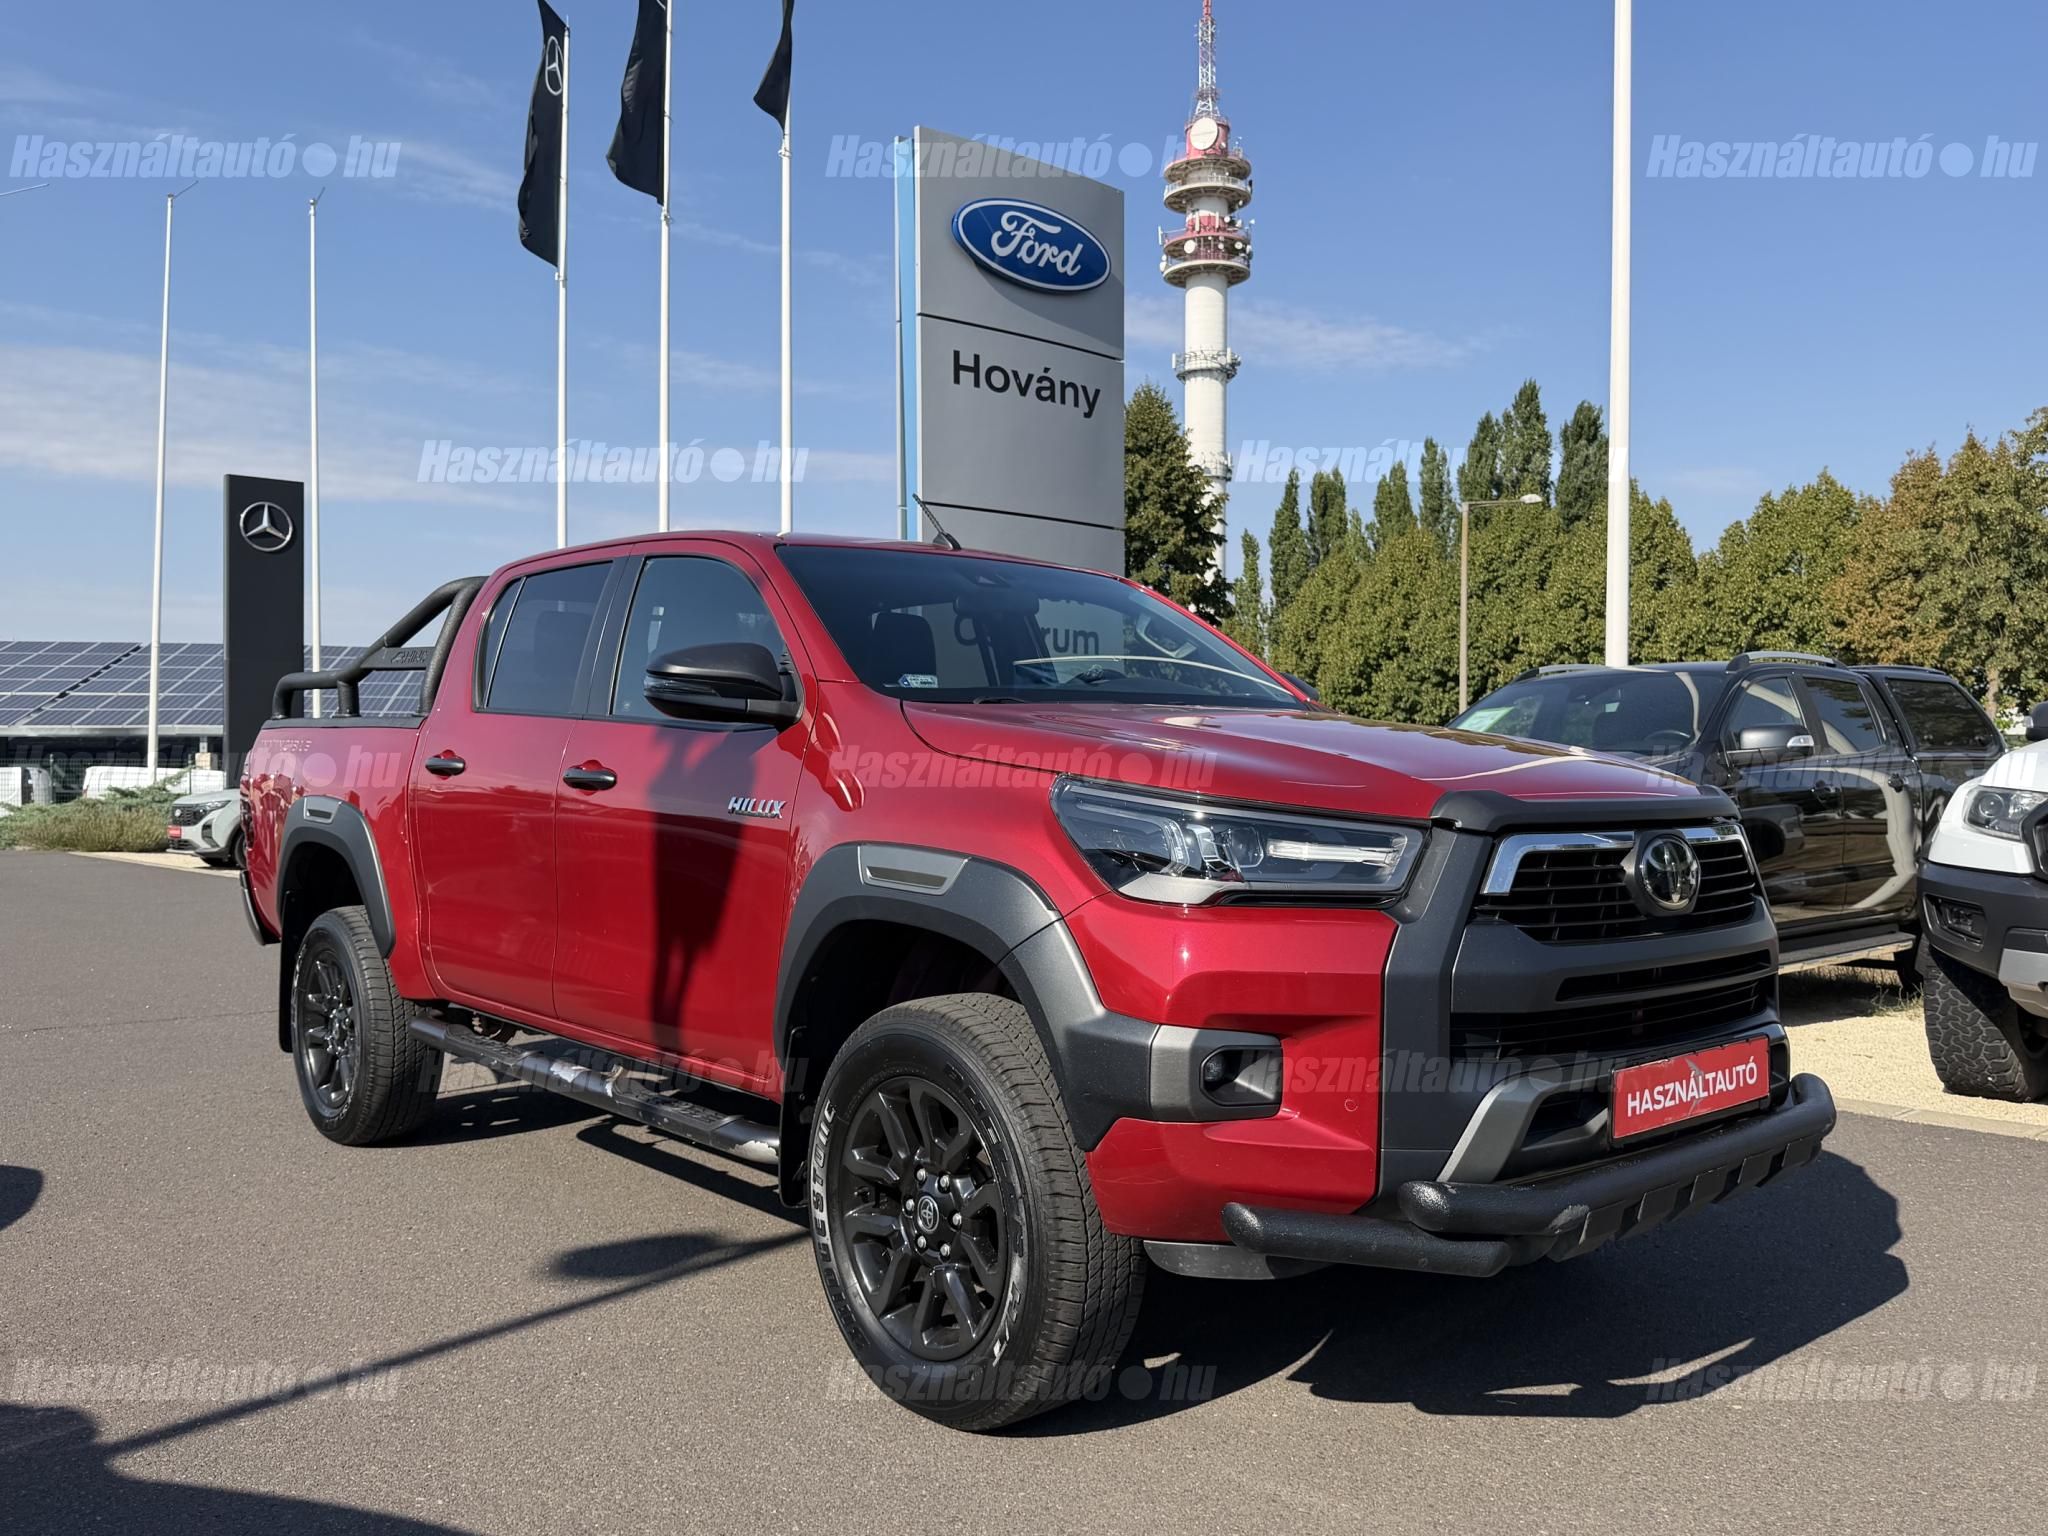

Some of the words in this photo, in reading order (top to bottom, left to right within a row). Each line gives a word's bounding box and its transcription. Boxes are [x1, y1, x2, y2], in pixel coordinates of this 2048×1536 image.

[990, 209, 1082, 277] Ford
[952, 350, 1101, 419] Hovány
[728, 796, 786, 819] HILUX
[1627, 1056, 1758, 1117] HASZNÁLTAUTÓ
